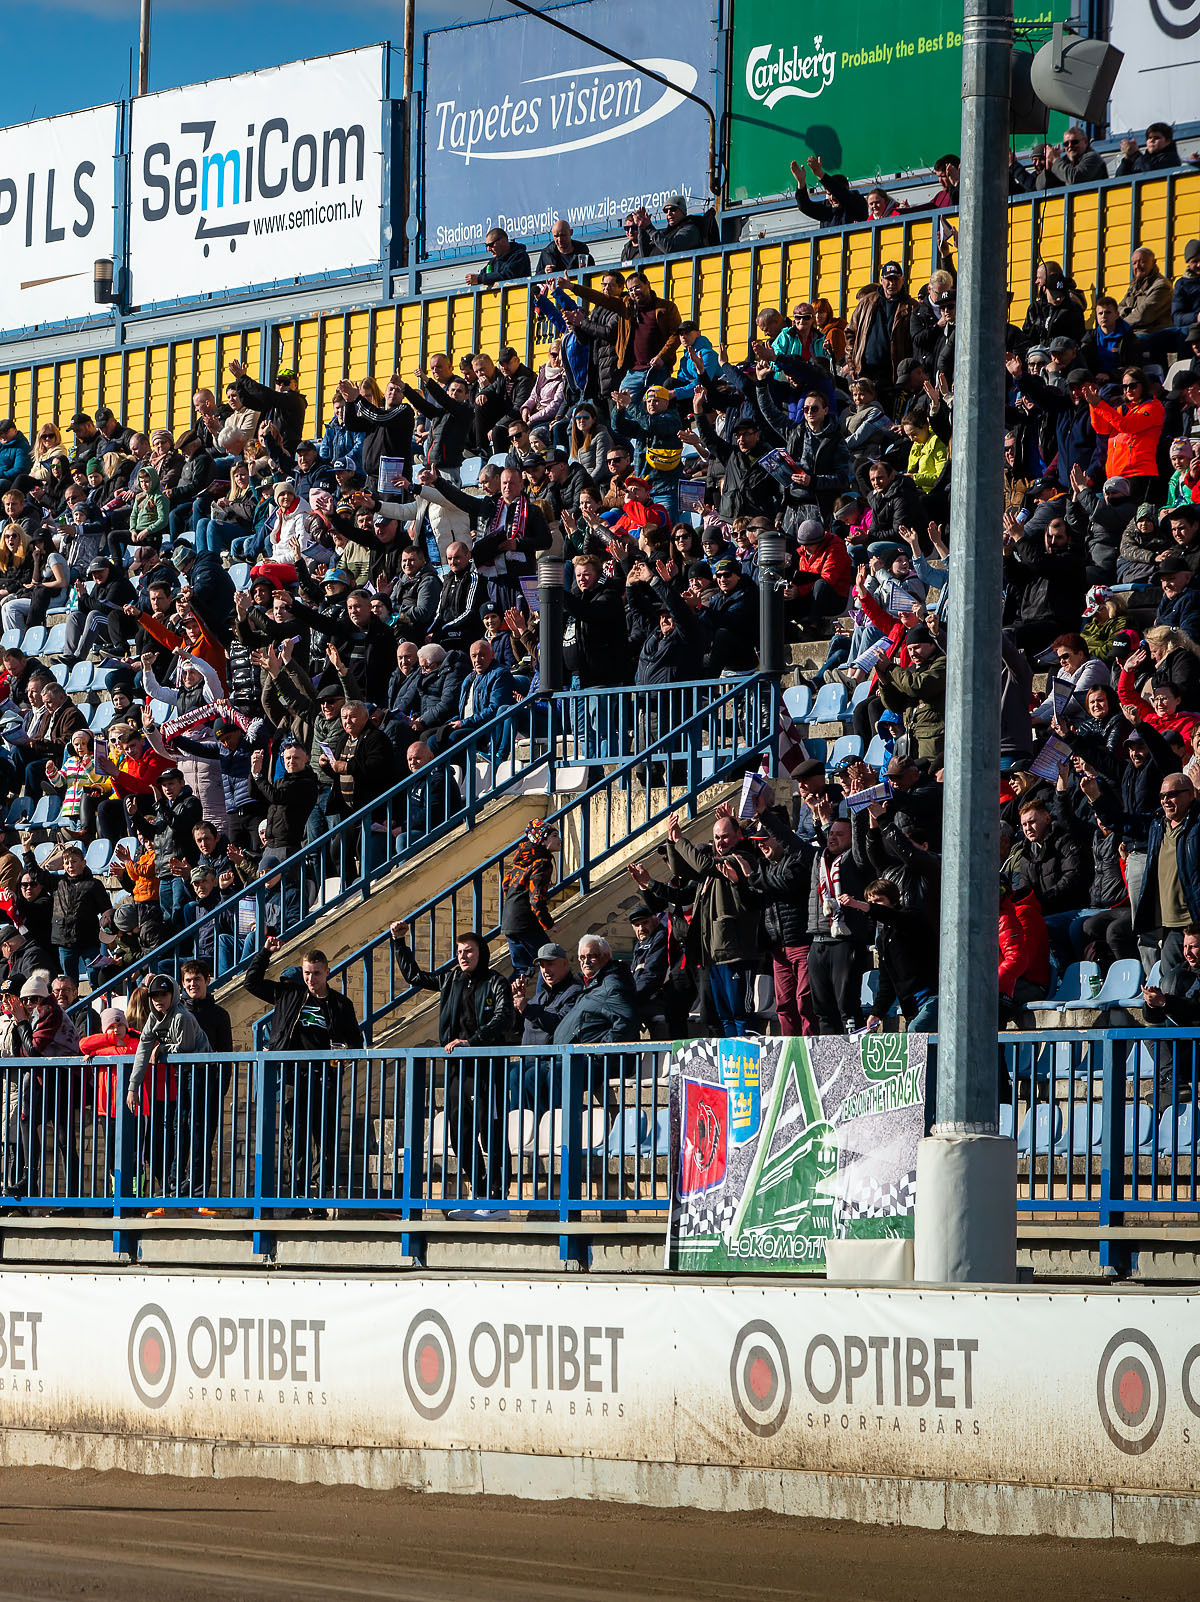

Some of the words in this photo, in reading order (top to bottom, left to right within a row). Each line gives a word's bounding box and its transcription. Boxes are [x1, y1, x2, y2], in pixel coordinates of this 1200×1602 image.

[841, 46, 893, 68] Probably
[896, 41, 913, 59] the
[917, 34, 944, 54] Best
[946, 31, 964, 48] Be
[745, 42, 836, 105] Carlsberg
[435, 94, 541, 166] Tapetes
[550, 77, 642, 130] visiem
[142, 117, 365, 222] SemiCom
[253, 194, 363, 236] www.semicom.lv
[436, 222, 483, 245] Stadiona
[498, 207, 560, 235] Daugavpils
[567, 183, 692, 222] www.zila-ezerzemlv
[866, 1033, 902, 1072] 52
[868, 1085, 883, 1112] THE
[884, 1066, 921, 1110] TRACK
[187, 1316, 326, 1382] OPTIBET
[468, 1321, 624, 1393] OPTIBET
[804, 1333, 979, 1409] OPTIBET
[0, 1374, 44, 1393] BĀRS
[188, 1386, 265, 1403] SPORTA
[278, 1387, 327, 1405] BĀRS
[470, 1396, 553, 1414] SPORTA
[570, 1398, 624, 1418] BĀRS
[807, 1412, 901, 1432] SPORTA
[919, 1414, 980, 1436] BĀRS
